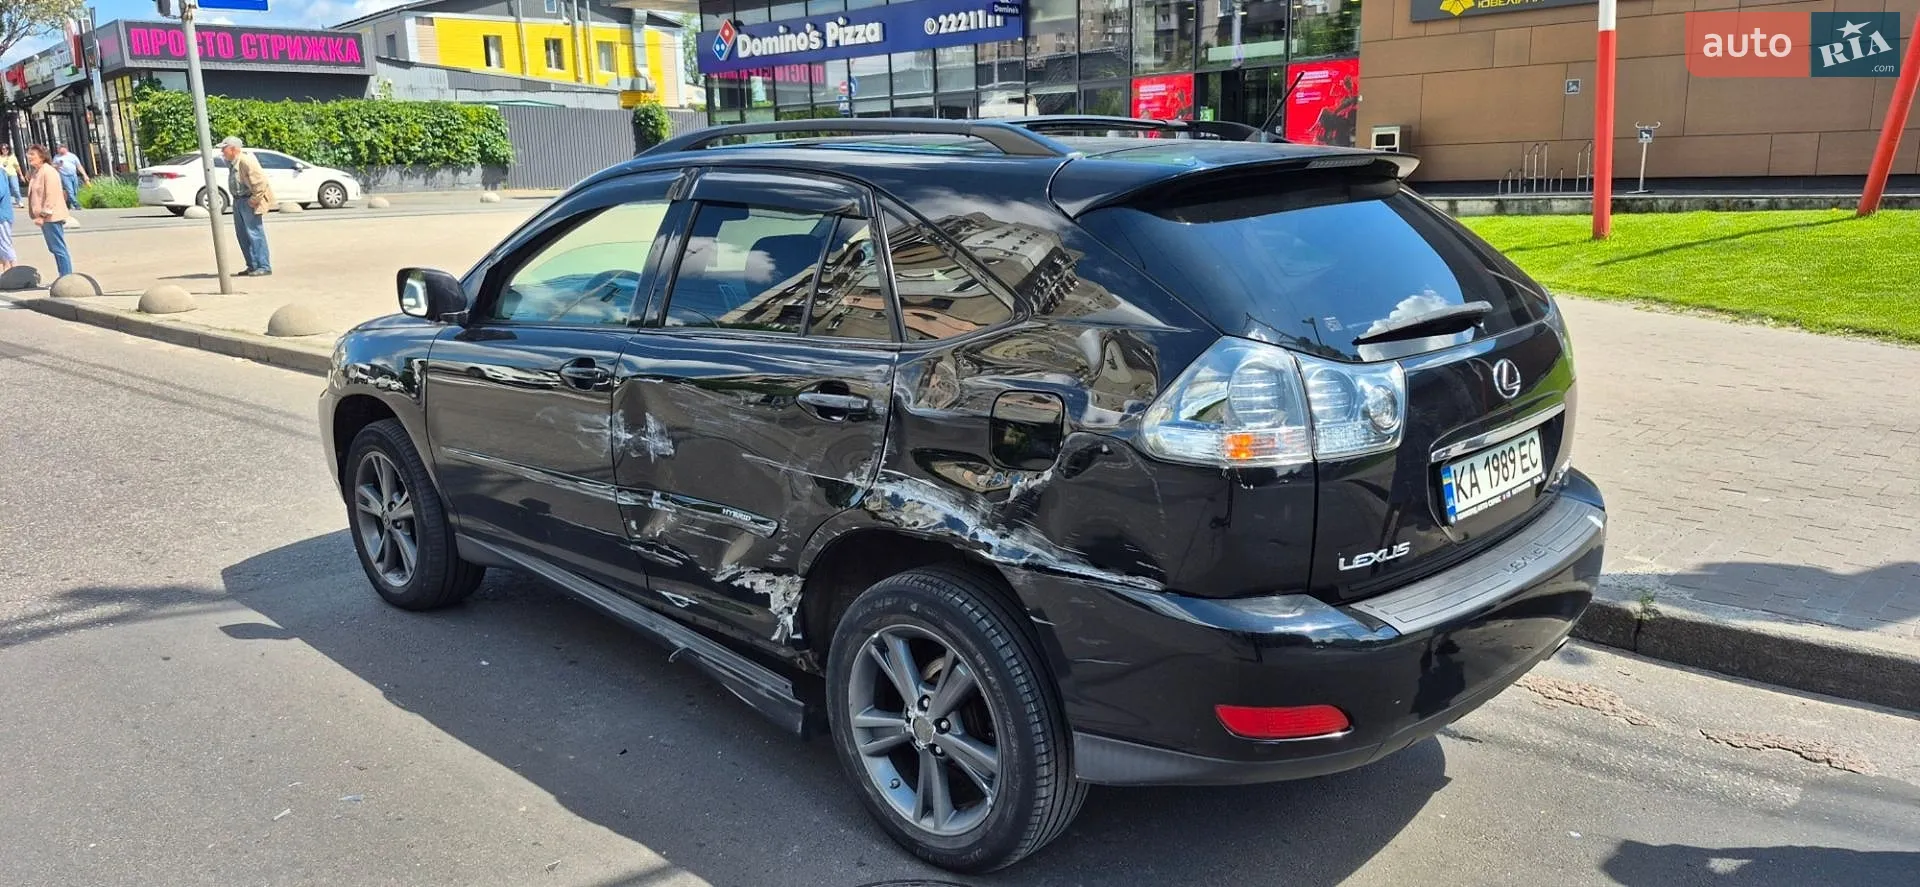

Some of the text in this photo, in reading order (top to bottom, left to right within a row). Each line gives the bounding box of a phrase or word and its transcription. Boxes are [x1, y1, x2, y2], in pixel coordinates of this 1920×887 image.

[240, 33, 361, 63] СТРИЖКА
[737, 16, 884, 58] Domino's Pizza
[1453, 462, 1482, 503] KA
[1483, 446, 1517, 489] 1989
[1518, 437, 1539, 474] EC
[1338, 541, 1411, 571] LEXUS
